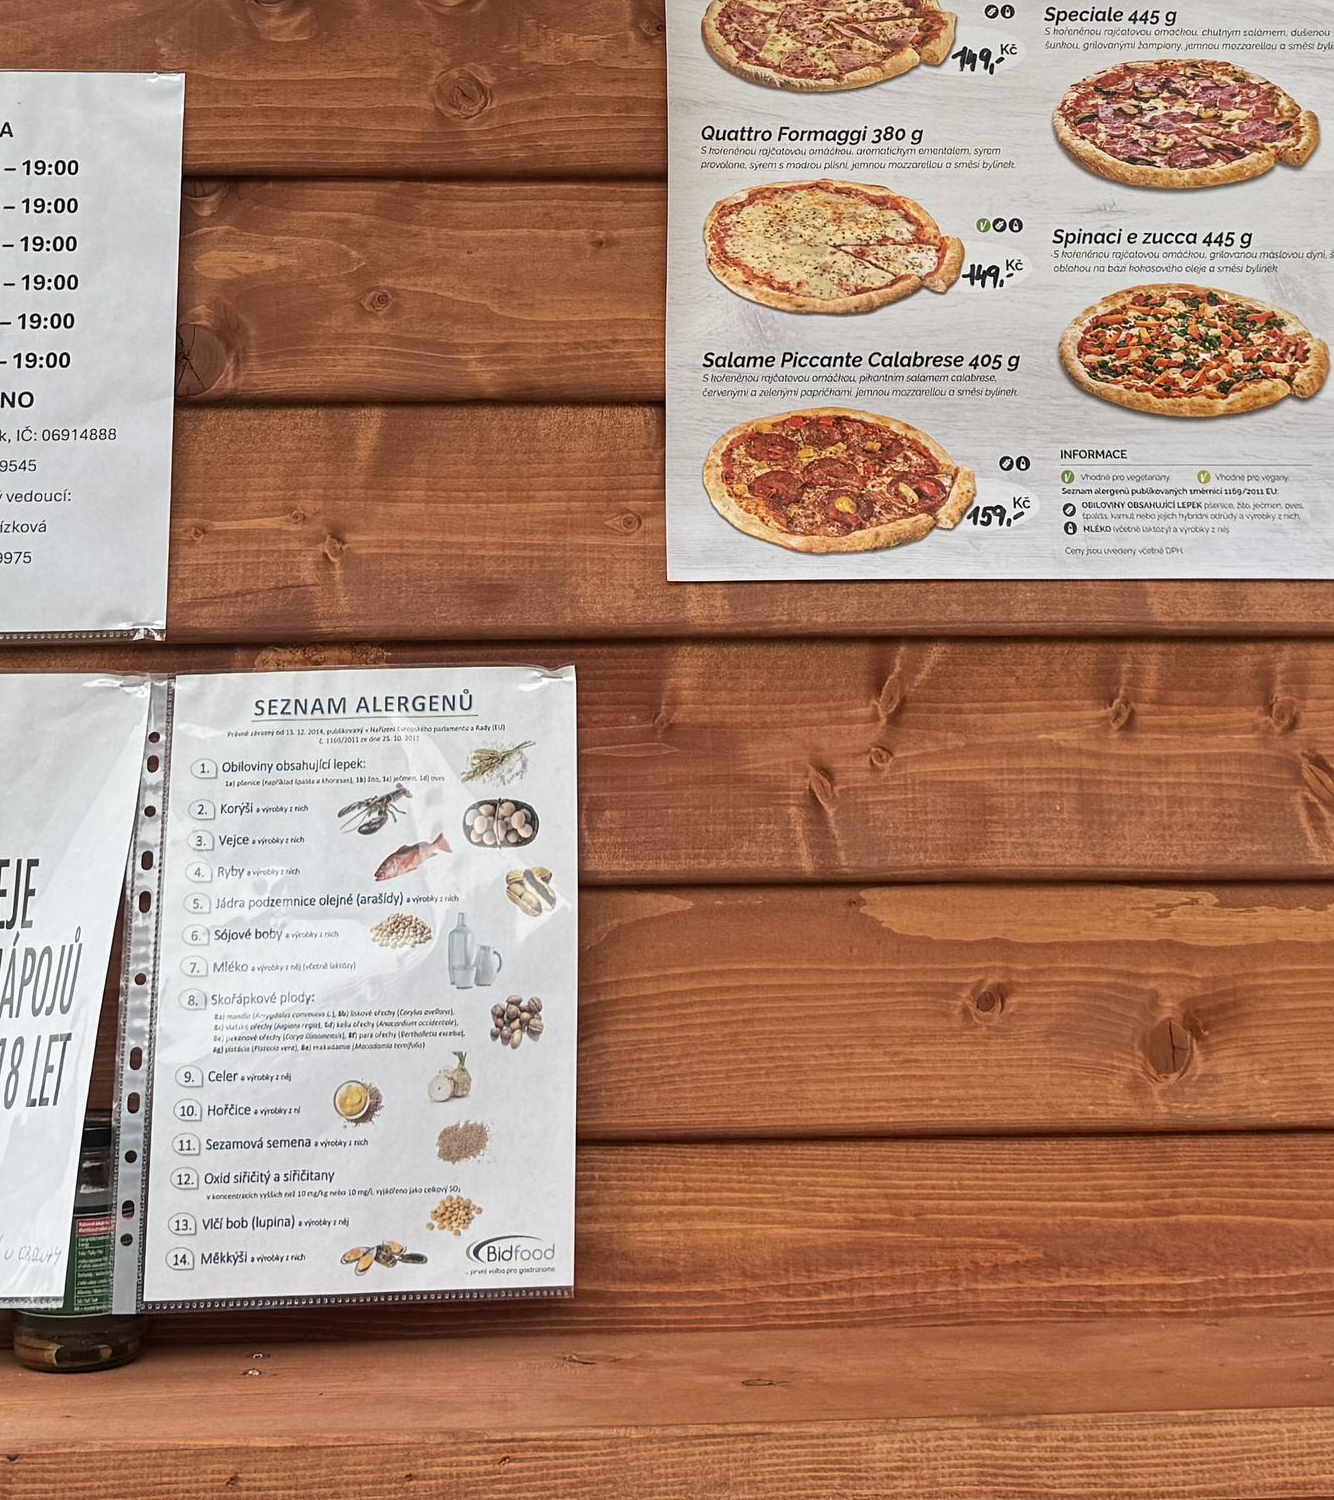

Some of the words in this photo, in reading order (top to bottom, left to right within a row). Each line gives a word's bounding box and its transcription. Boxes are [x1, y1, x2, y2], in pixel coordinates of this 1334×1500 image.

[1044, 7, 1123, 25] Speciale
[1128, 10, 1160, 24] 445
[1165, 11, 1177, 26] g
[1000, 44, 1017, 55] Kč
[701, 126, 772, 142] Quattro
[778, 126, 867, 145] Formaggi
[871, 126, 906, 143] 380
[911, 128, 923, 144] g
[22, 160, 79, 176] 19:00
[21, 198, 78, 214] 19:00
[20, 236, 77, 252] 19:00
[1053, 229, 1122, 247] Spinaci
[1127, 233, 1138, 245] e
[1143, 232, 1197, 245] zucca
[1202, 232, 1235, 246] 445
[1240, 232, 1252, 248] g
[1006, 258, 1023, 271] Kč
[21, 275, 78, 291] 19:00
[17, 313, 75, 329] 19:00
[13, 352, 71, 369] 19:00
[702, 352, 775, 368] Salame
[781, 352, 862, 368] Piccante
[868, 352, 964, 368] Calabrese
[969, 354, 1002, 370] 405
[1007, 355, 1020, 372] g
[17, 424, 37, 443] IČ:
[42, 428, 117, 443] 06914888
[1061, 450, 1127, 459] INFORMACE
[7, 488, 72, 503] vedoucí:
[1013, 496, 1030, 509] Kč
[254, 697, 347, 716] SEZNAM
[356, 688, 473, 713] ALERGENŮ
[200, 763, 210, 774] 1.
[222, 760, 273, 774] Obiloviny
[276, 758, 331, 773] obsahující
[333, 757, 366, 772] lepek:
[197, 805, 208, 815] 2.
[220, 802, 253, 816] Korýši
[196, 836, 206, 847] 3.
[219, 834, 249, 847] Vejce
[194, 867, 205, 877] 4.
[217, 866, 244, 880] Ryby
[193, 899, 203, 909] 5.
[215, 896, 245, 910] Jádra
[248, 894, 316, 911] podzemnice
[319, 893, 353, 909] olejné
[356, 892, 404, 908] (arašídy)
[191, 930, 201, 941] 6.
[214, 927, 251, 944] Sójové
[255, 927, 283, 942] boby
[190, 962, 200, 973] 7.
[213, 960, 248, 972] Mléko
[188, 995, 199, 1005] 8.
[211, 991, 277, 1008] Skořápkové
[280, 991, 315, 1005] plody:
[26, 1032, 72, 1108] LET
[184, 1071, 195, 1082] 9.
[208, 1070, 238, 1082] Celer
[179, 1105, 198, 1117] 10.
[207, 1103, 251, 1117] Hořčice
[178, 1139, 196, 1151] 11.
[206, 1137, 263, 1150] Sezamová
[267, 1137, 311, 1148] semena
[176, 1174, 194, 1185] 12.
[204, 1172, 231, 1185] Oxid
[234, 1170, 271, 1186] siřičitý
[273, 1173, 280, 1182] a
[283, 1169, 334, 1186] siřičitany
[174, 1218, 192, 1230] 13.
[202, 1215, 223, 1229] Vlčí
[226, 1216, 248, 1229] bob
[251, 1215, 295, 1231] (lupina)
[173, 1254, 191, 1265] 14.
[201, 1250, 247, 1268] Měkkýši
[487, 1244, 555, 1262] Bidfood
